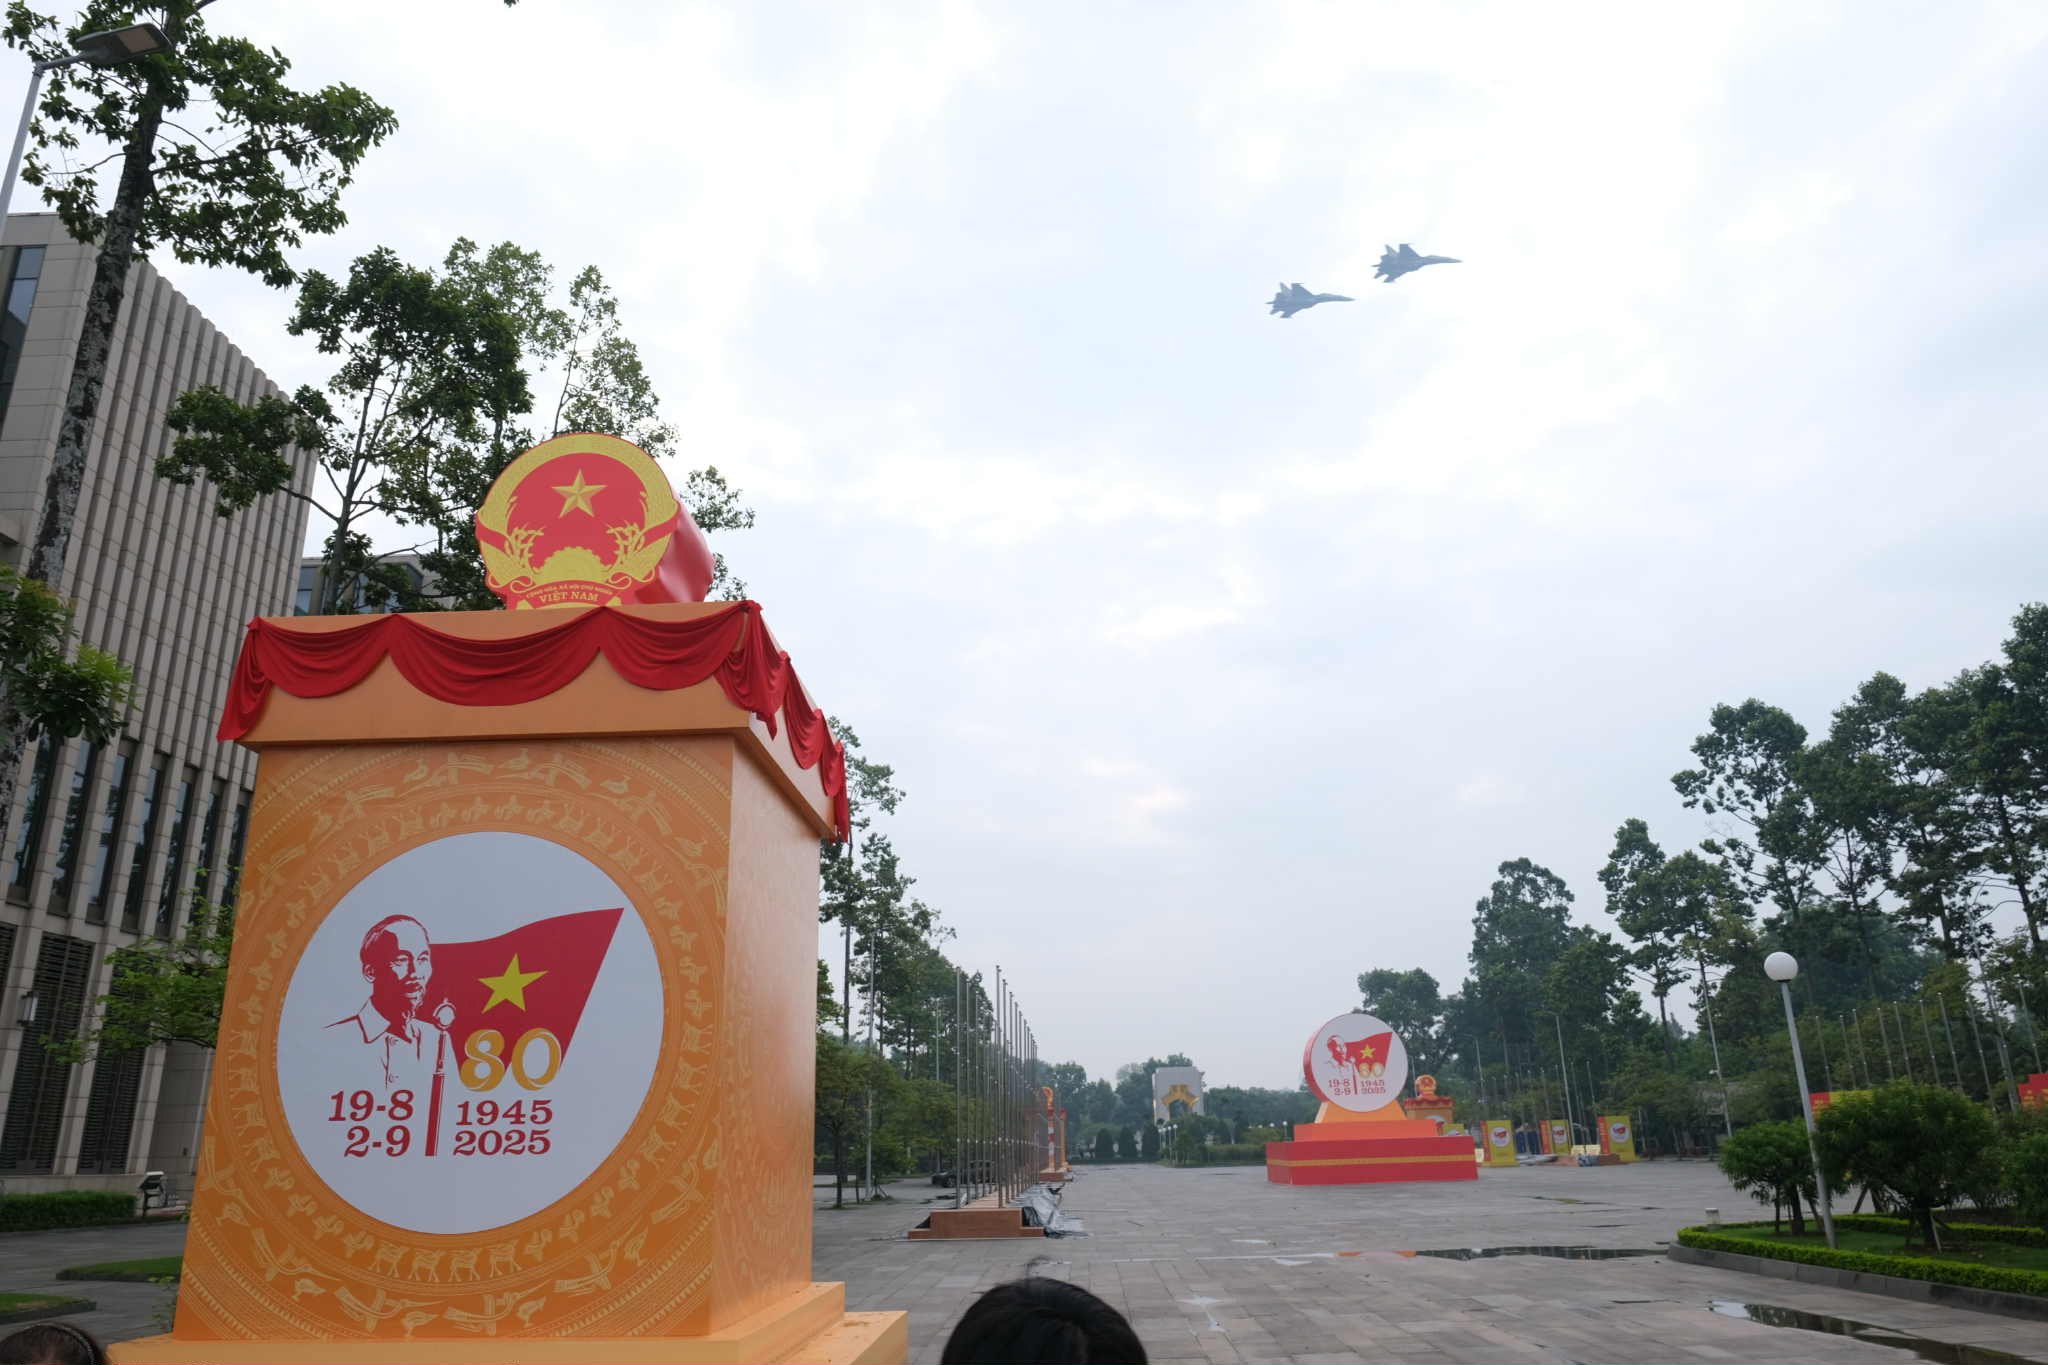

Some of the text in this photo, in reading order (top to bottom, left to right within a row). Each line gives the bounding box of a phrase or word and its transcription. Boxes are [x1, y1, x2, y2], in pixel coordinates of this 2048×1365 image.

[571, 591, 599, 601] NAM
[460, 1027, 562, 1092] 80
[1359, 1062, 1386, 1078] 80
[328, 1089, 414, 1122] 19-8
[455, 1100, 553, 1126] 1945
[344, 1125, 411, 1158] 2-9
[453, 1129, 551, 1156] 2025
